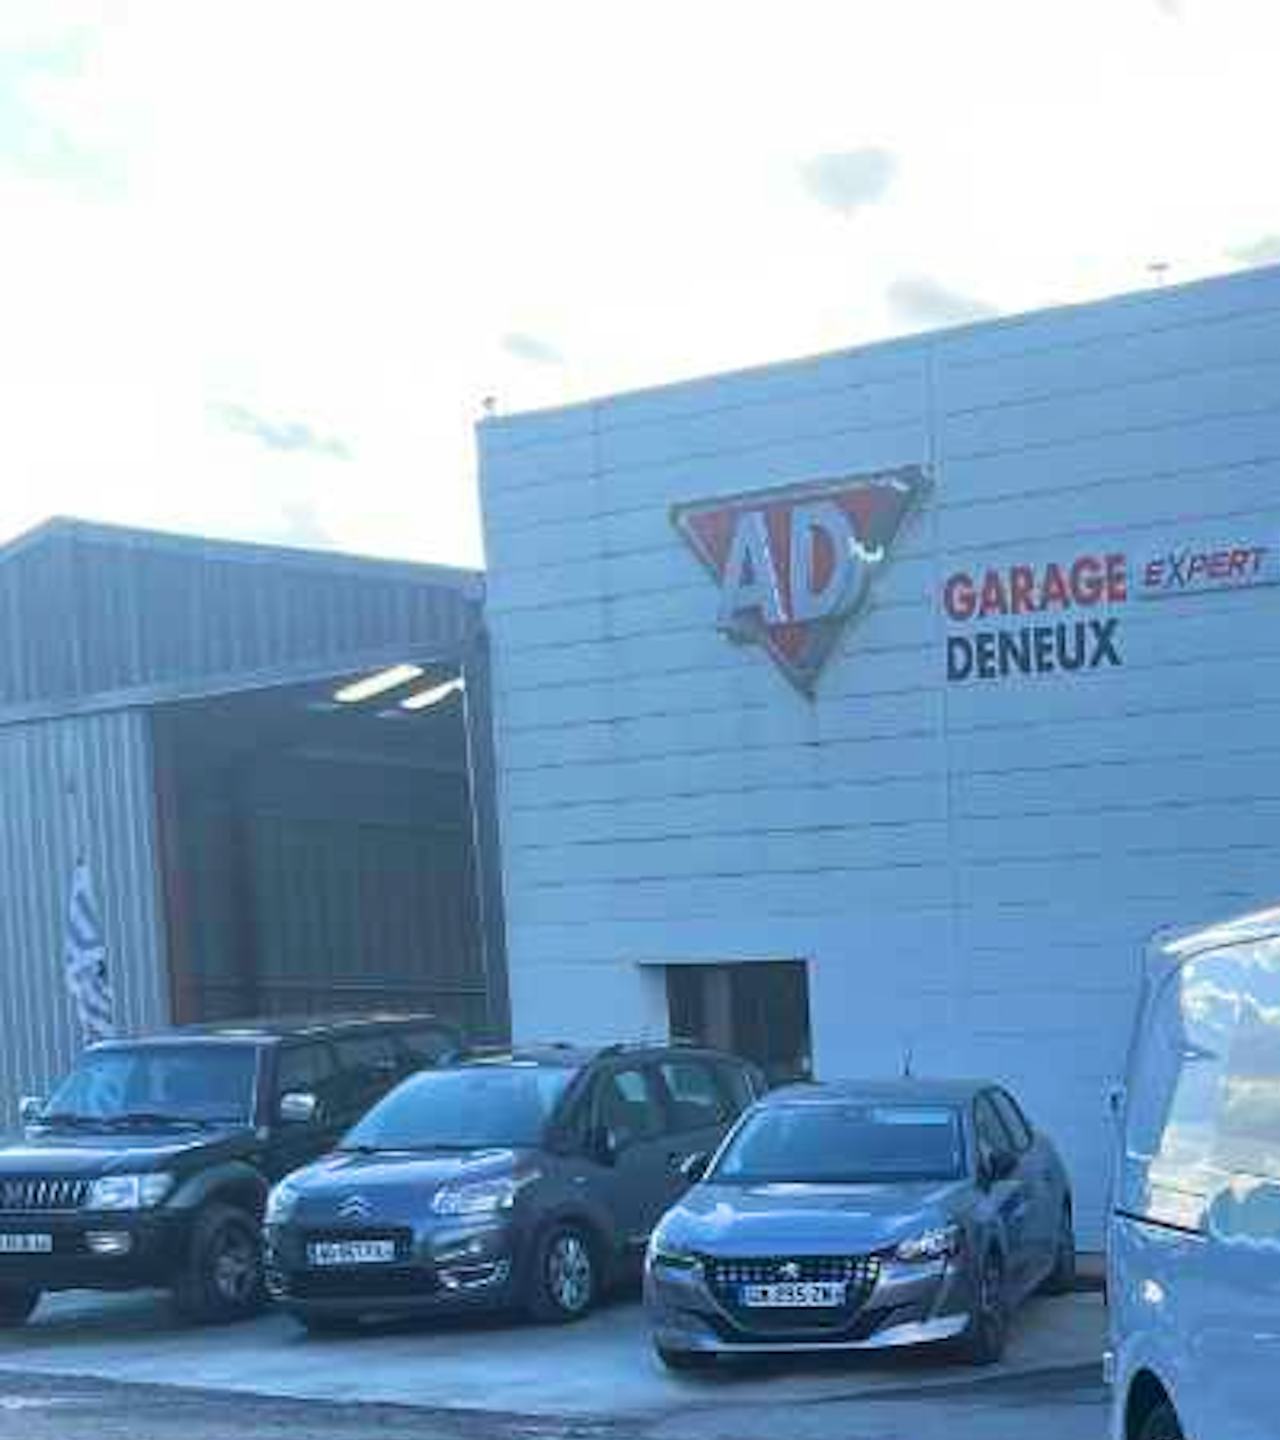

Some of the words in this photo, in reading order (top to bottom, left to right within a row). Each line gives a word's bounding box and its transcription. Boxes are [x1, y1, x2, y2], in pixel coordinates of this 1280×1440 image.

[716, 500, 862, 625] AD
[943, 552, 1128, 623] GARAGE
[945, 617, 1122, 682] DENEUX
